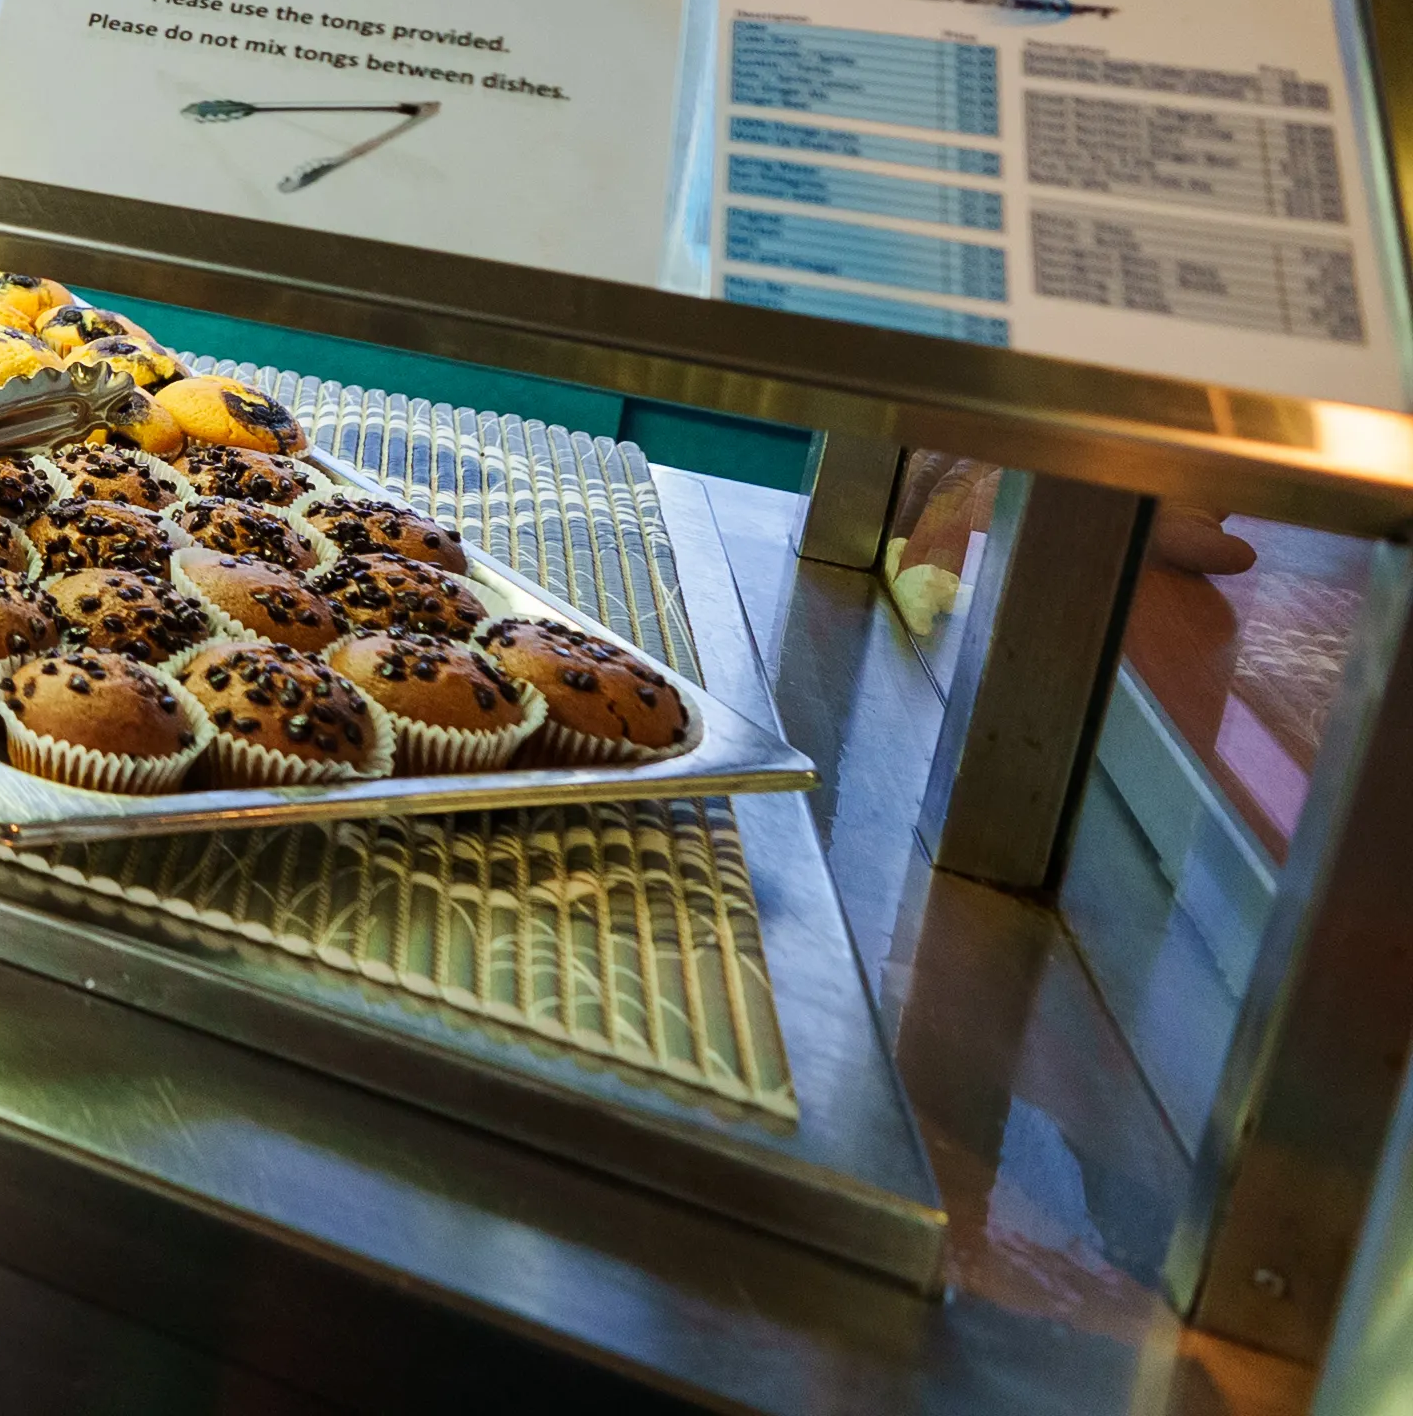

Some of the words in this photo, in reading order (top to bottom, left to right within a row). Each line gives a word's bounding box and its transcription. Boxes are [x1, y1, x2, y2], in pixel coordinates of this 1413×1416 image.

[88, 12, 158, 37] Please
[164, 25, 193, 42] do
[199, 32, 239, 49] not
[244, 39, 287, 57] mix
[294, 45, 359, 69] tongs
[366, 53, 474, 85] between
[481, 72, 570, 101] dishes.
[230, 1, 269, 18] use
[276, 6, 314, 25] the
[321, 13, 386, 37] tongs
[392, 24, 510, 53] provided.
